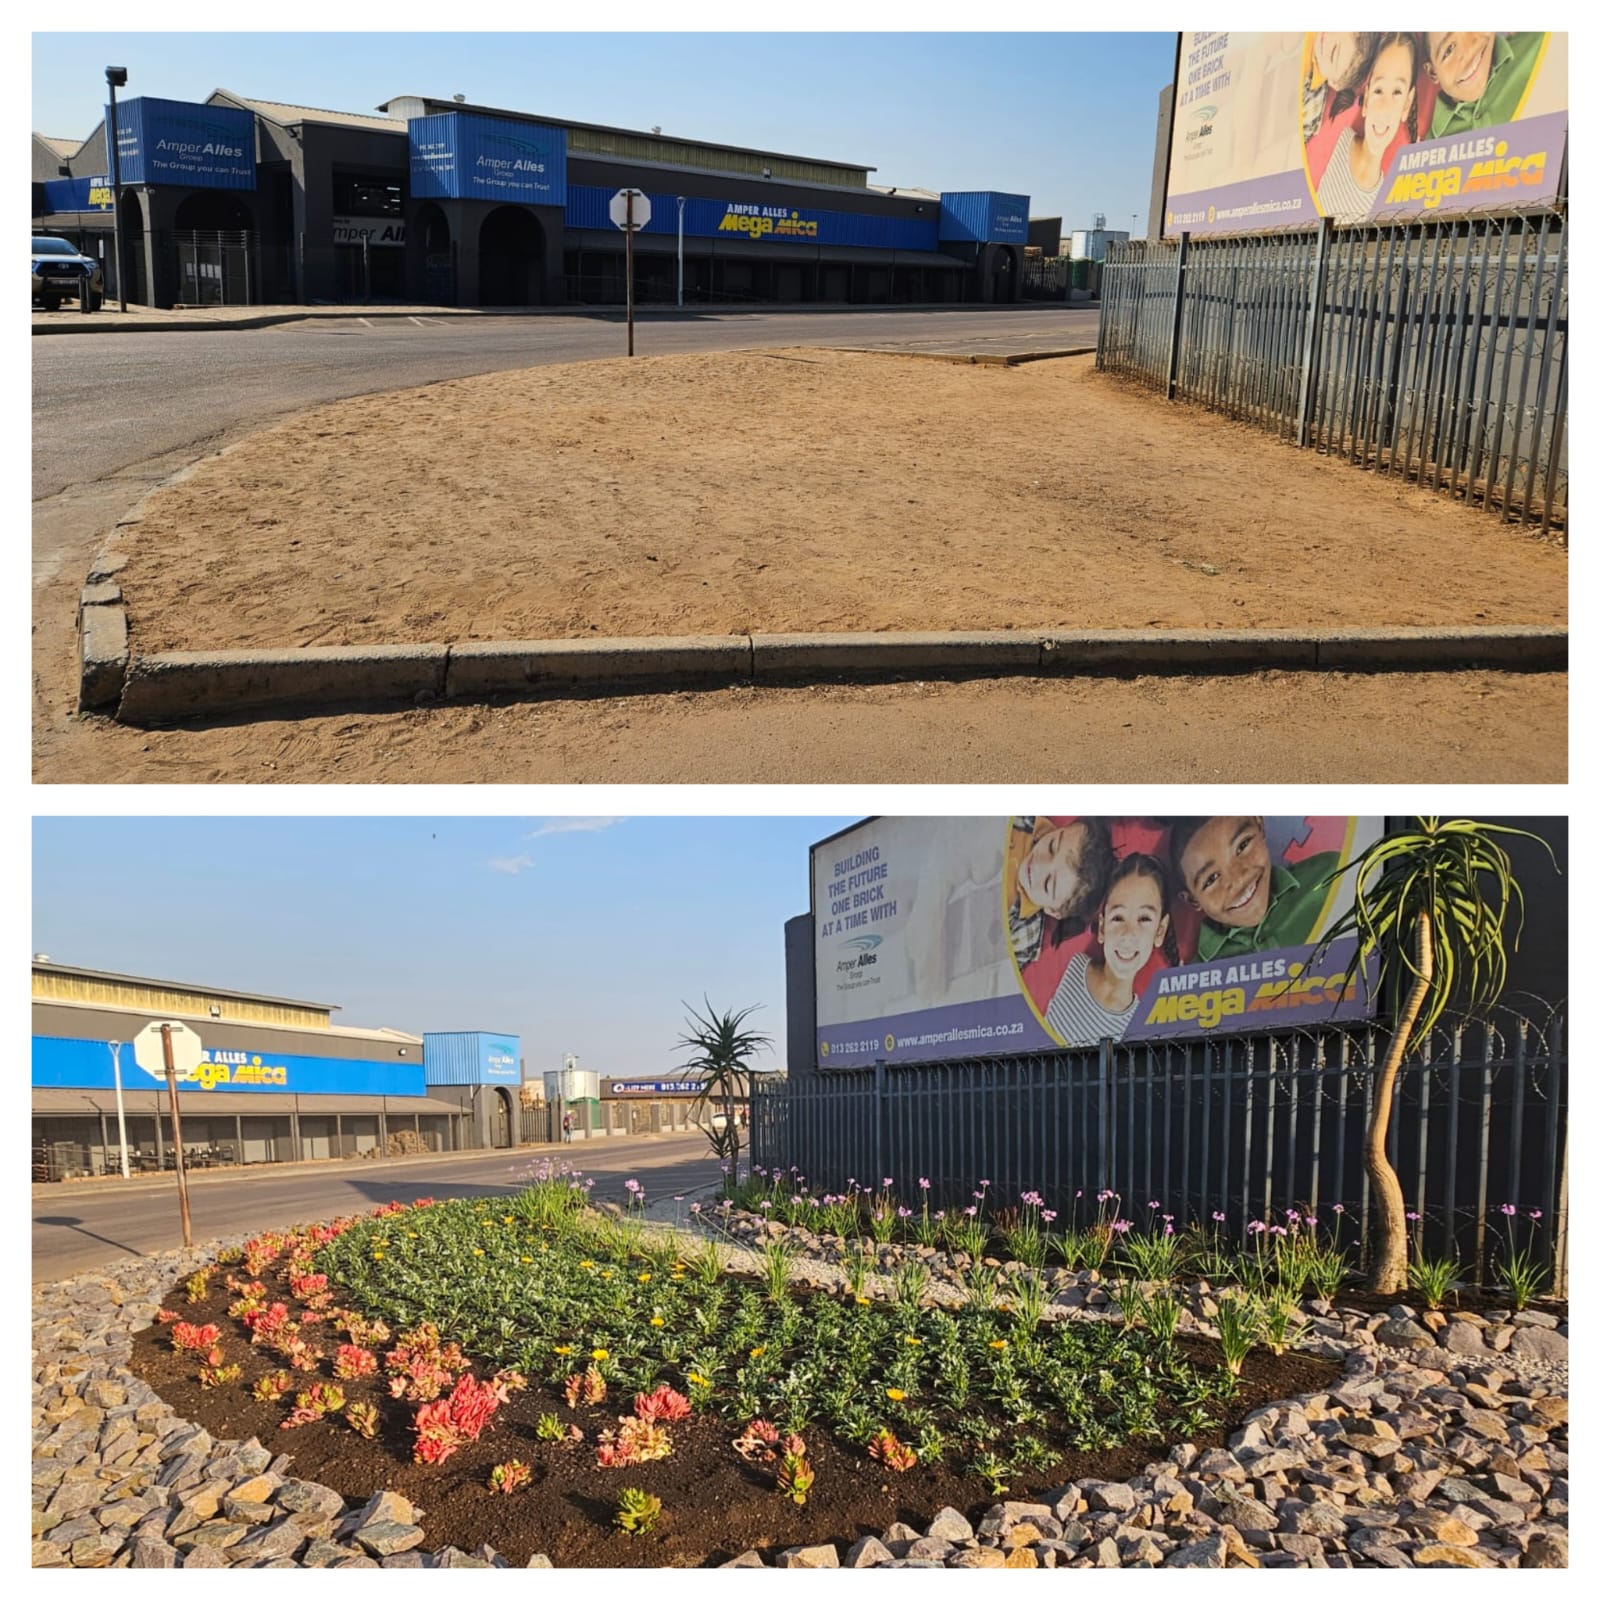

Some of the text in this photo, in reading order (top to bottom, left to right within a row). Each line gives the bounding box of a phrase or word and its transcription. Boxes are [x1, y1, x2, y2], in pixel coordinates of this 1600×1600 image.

[1188, 32, 1230, 68] THE FUTURE
[1188, 55, 1225, 86] ONE BRICK
[1211, 71, 1231, 92] WITH
[156, 139, 201, 153] Amper
[201, 143, 243, 158] Alles
[1399, 137, 1496, 172] AMPER ALLES
[152, 160, 251, 177] The Group you can Trust
[476, 155, 545, 173] Amper Alles
[473, 176, 485, 185] The
[727, 203, 788, 218] AMPER ALLES
[333, 227, 376, 242] mper
[834, 846, 880, 877] BUILDING
[828, 863, 888, 899] THE FUTURE
[831, 884, 884, 916] ONE BRICK
[822, 901, 897, 938] AT A TIME WITH
[836, 952, 877, 973] Amper Alles
[1158, 959, 1286, 994] AMPER ALLES
[1144, 987, 1246, 1029] Mega
[831, 1039, 879, 1054] 013 262 2119
[897, 1022, 1024, 1048] www.amperallesmica.co.za
[214, 1051, 248, 1064] ALLES
